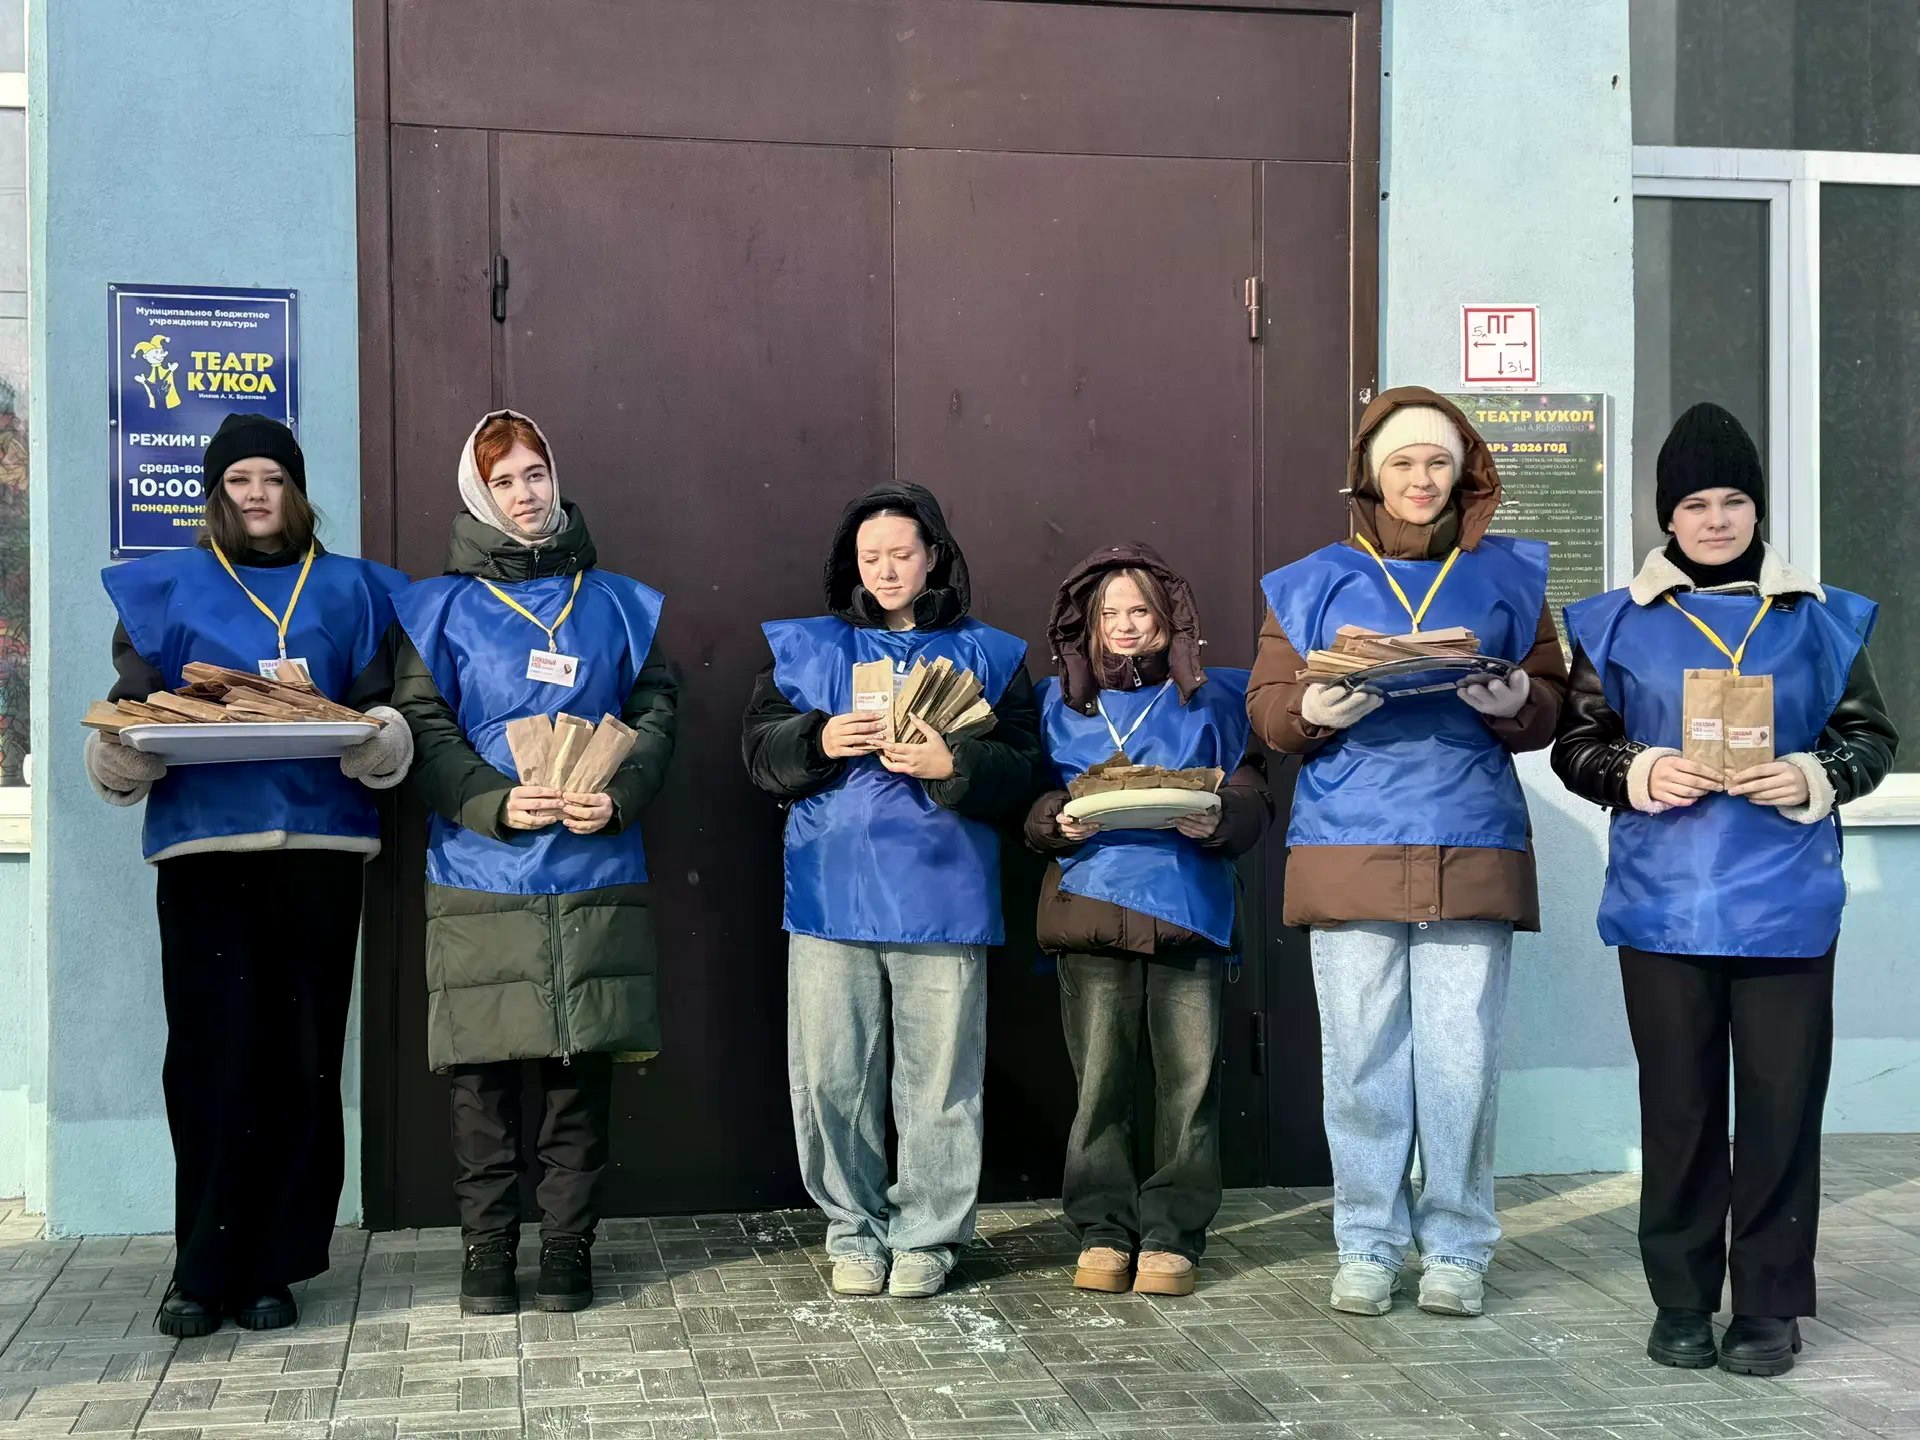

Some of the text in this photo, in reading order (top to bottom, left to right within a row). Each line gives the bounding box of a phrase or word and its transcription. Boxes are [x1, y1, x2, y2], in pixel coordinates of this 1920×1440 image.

[135, 307, 270, 319] Муниципальное бюджетное
[148, 317, 258, 328] учреждение культуры
[1487, 314, 1515, 334] ПГ
[190, 351, 274, 372] ТЕАТР
[187, 371, 277, 393] КУКОЛ
[1475, 409, 1595, 423] ТЕАТР КУКОЛ
[129, 433, 196, 447] РЕЖИМ
[1485, 443, 1568, 454] АРЬ 2026 ГОД
[172, 518, 207, 527] выхо
